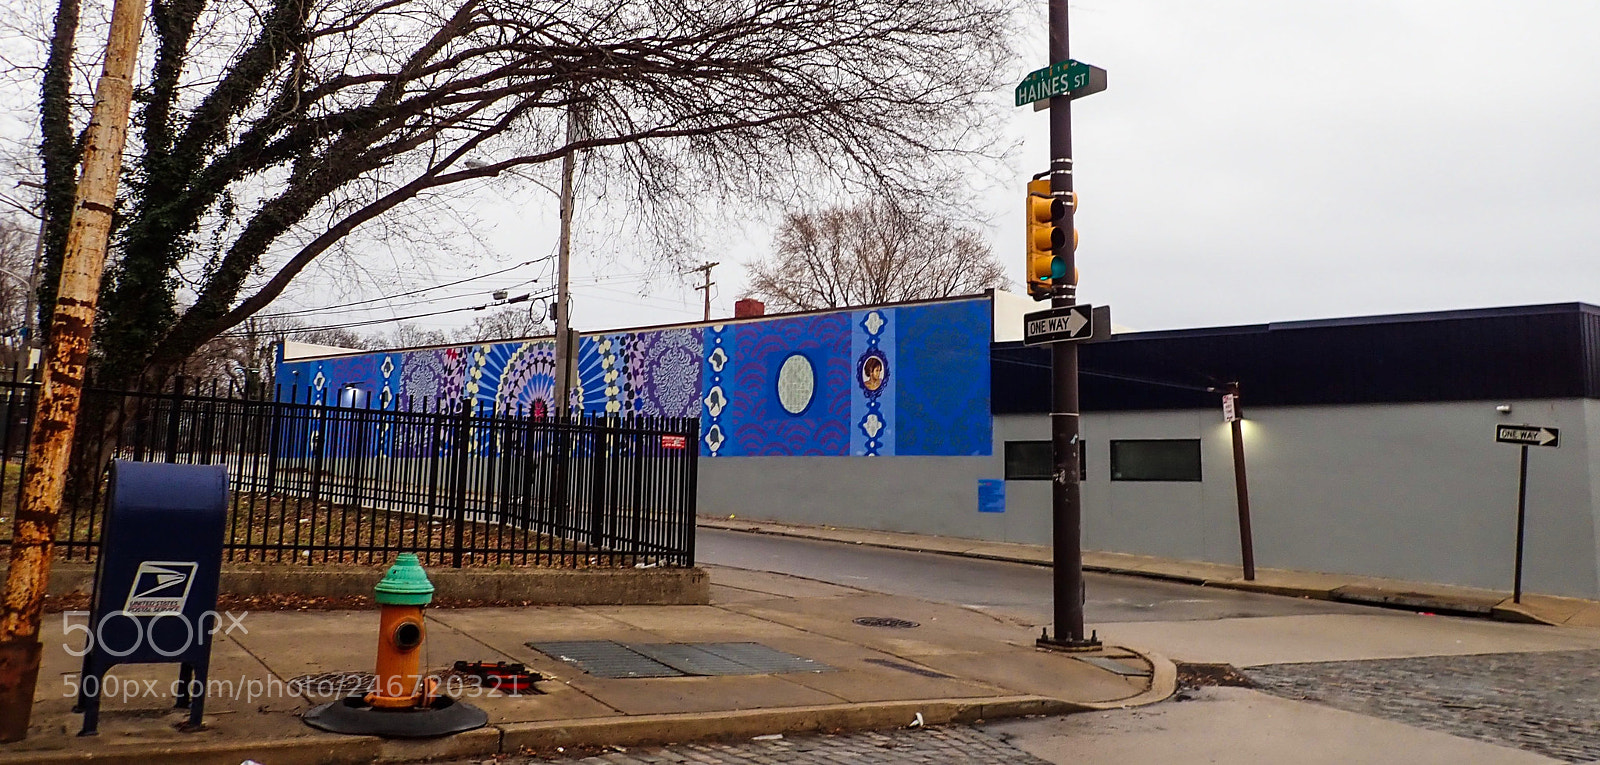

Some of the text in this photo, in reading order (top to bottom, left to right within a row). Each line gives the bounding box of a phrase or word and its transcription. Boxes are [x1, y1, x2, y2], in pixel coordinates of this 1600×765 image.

[1018, 73, 1086, 105] HAINES ST
[1030, 316, 1070, 335] ONE WAY
[1501, 429, 1538, 440] ONE WAY
